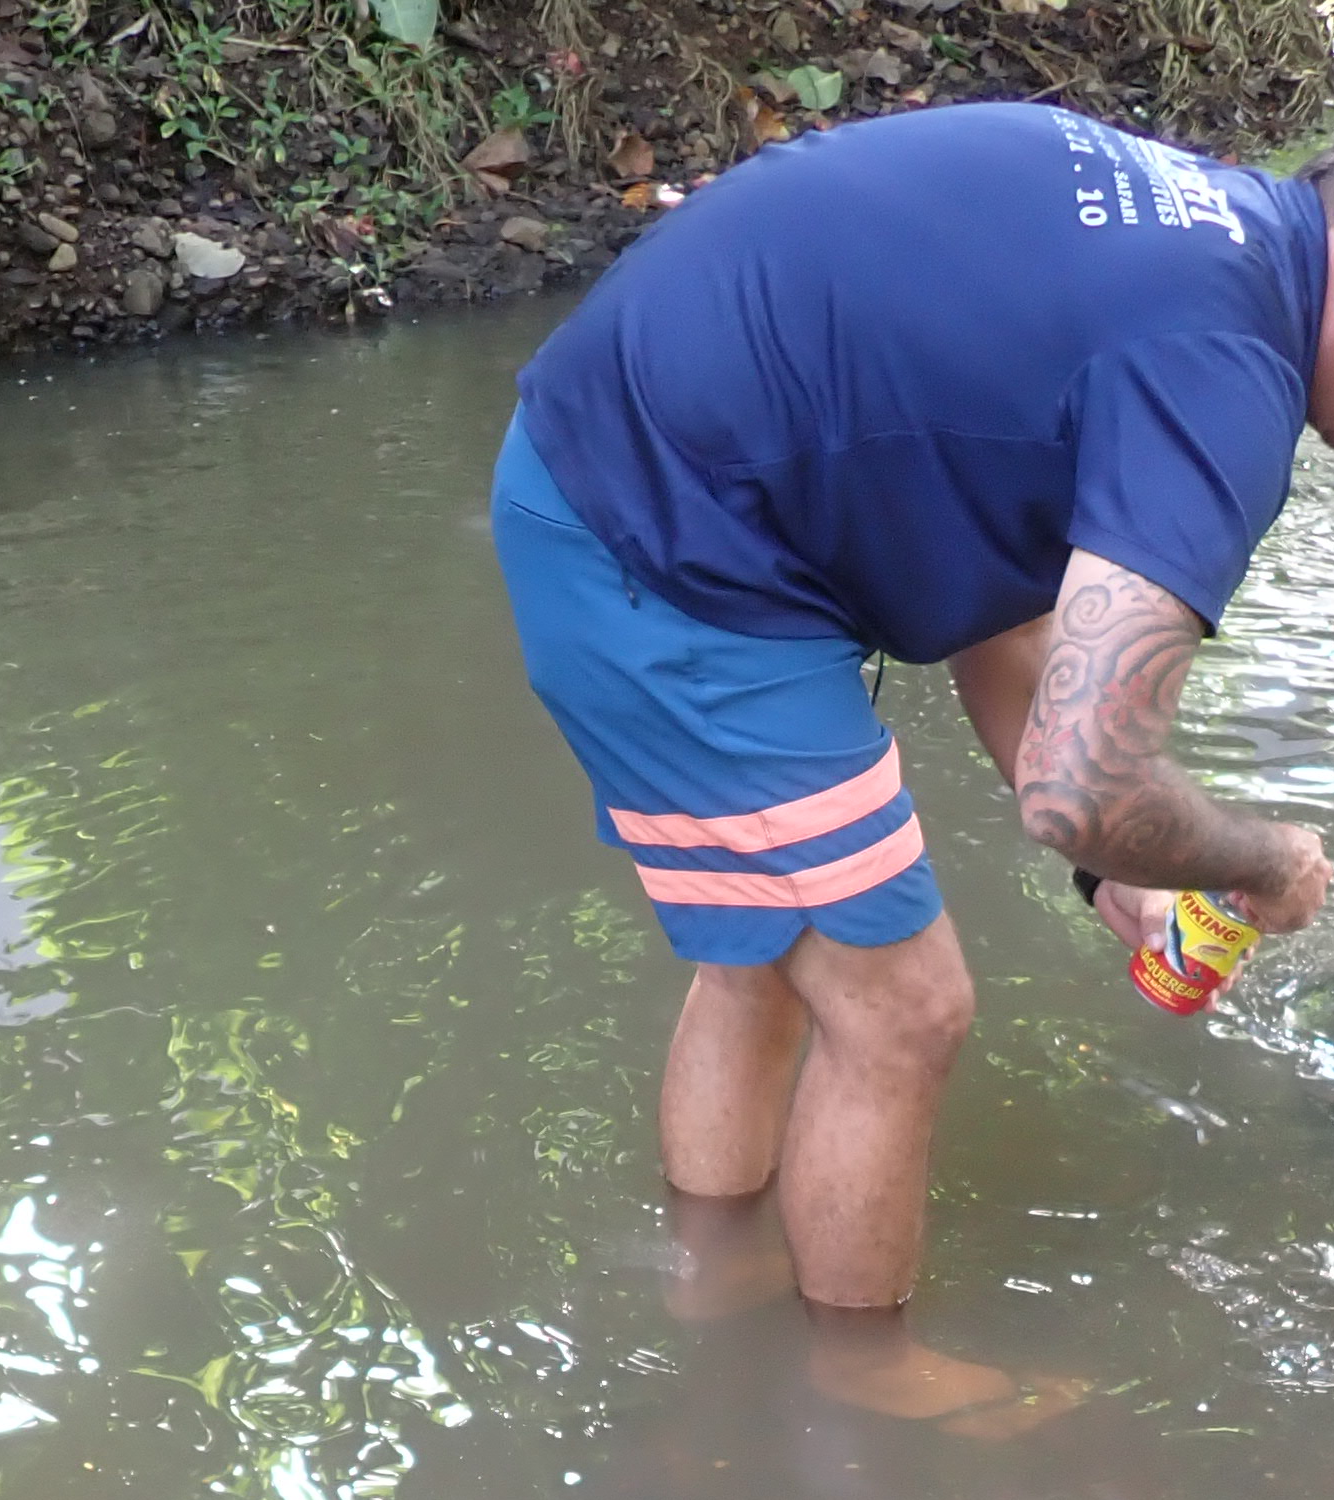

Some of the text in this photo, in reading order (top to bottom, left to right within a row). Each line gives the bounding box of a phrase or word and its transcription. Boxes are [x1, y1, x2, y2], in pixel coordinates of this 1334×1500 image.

[1076, 187, 1108, 227] 10
[1114, 171, 1139, 224] SAFARI
[1181, 890, 1242, 942] VIKING
